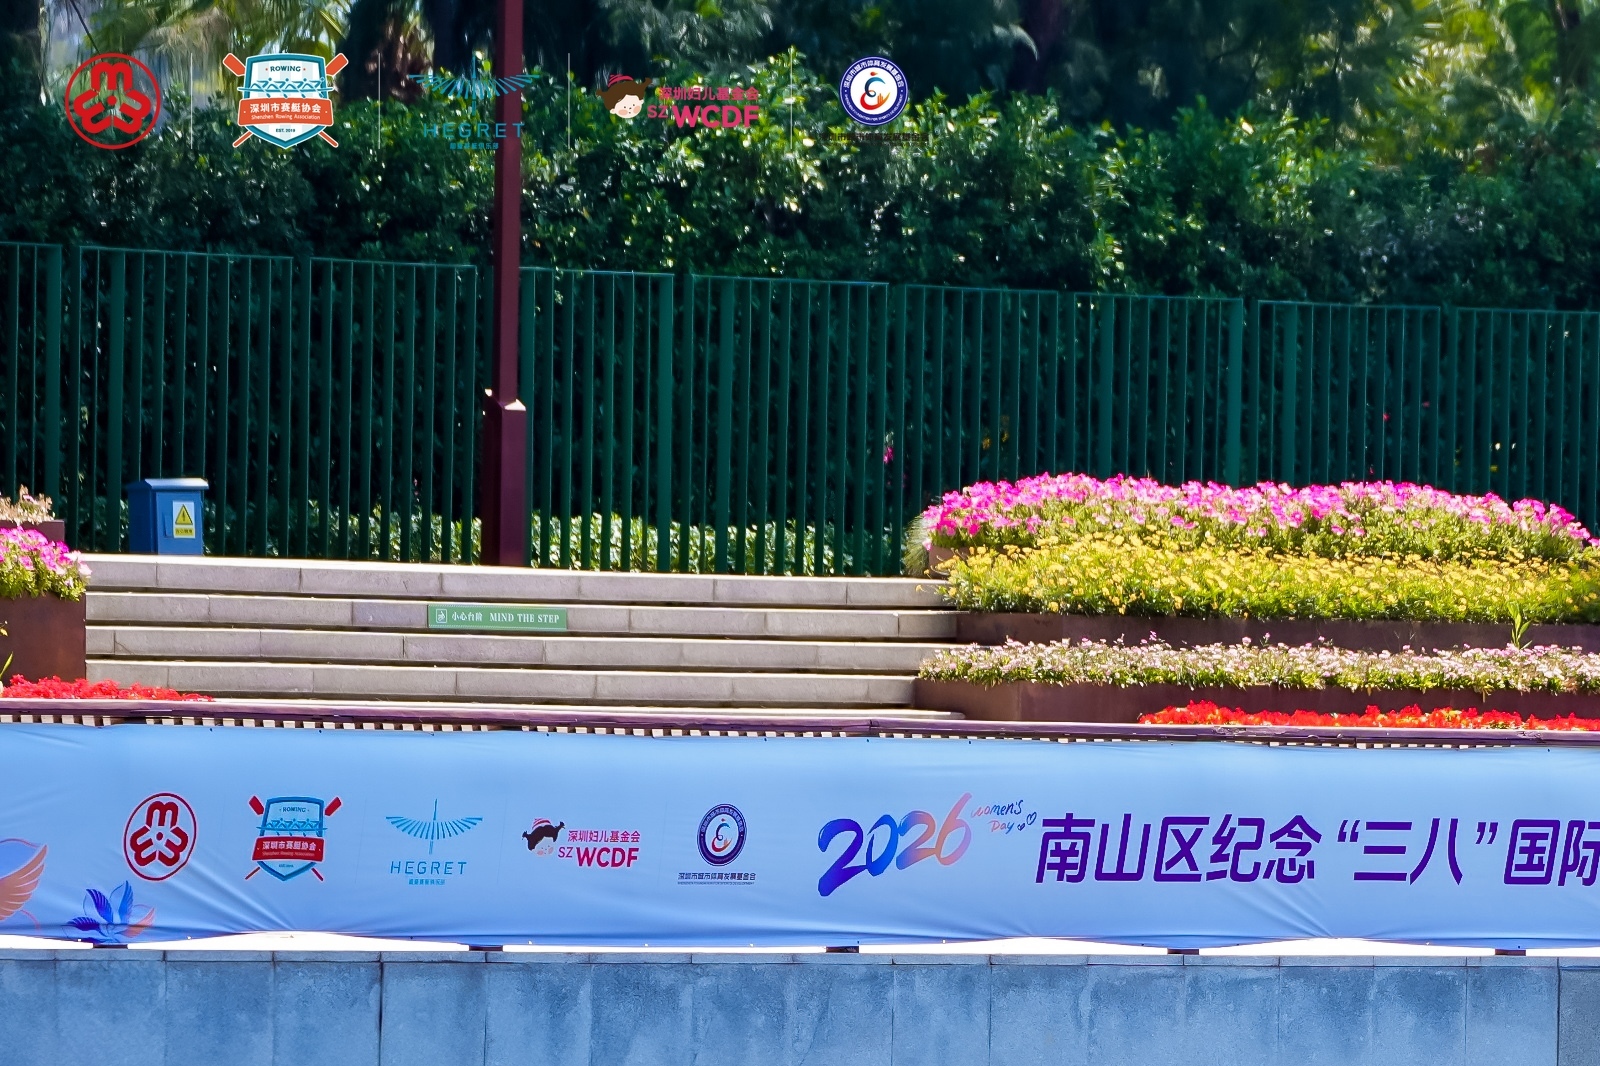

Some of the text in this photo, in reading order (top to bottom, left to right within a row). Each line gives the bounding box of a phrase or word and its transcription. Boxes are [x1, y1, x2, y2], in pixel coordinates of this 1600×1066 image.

[489, 612, 560, 624] MIND THE STEP
[568, 830, 640, 843] 深圳妇儿基金会
[817, 792, 973, 897] 2026
[576, 847, 640, 868] WCDF
[390, 860, 467, 875] HEGRET
